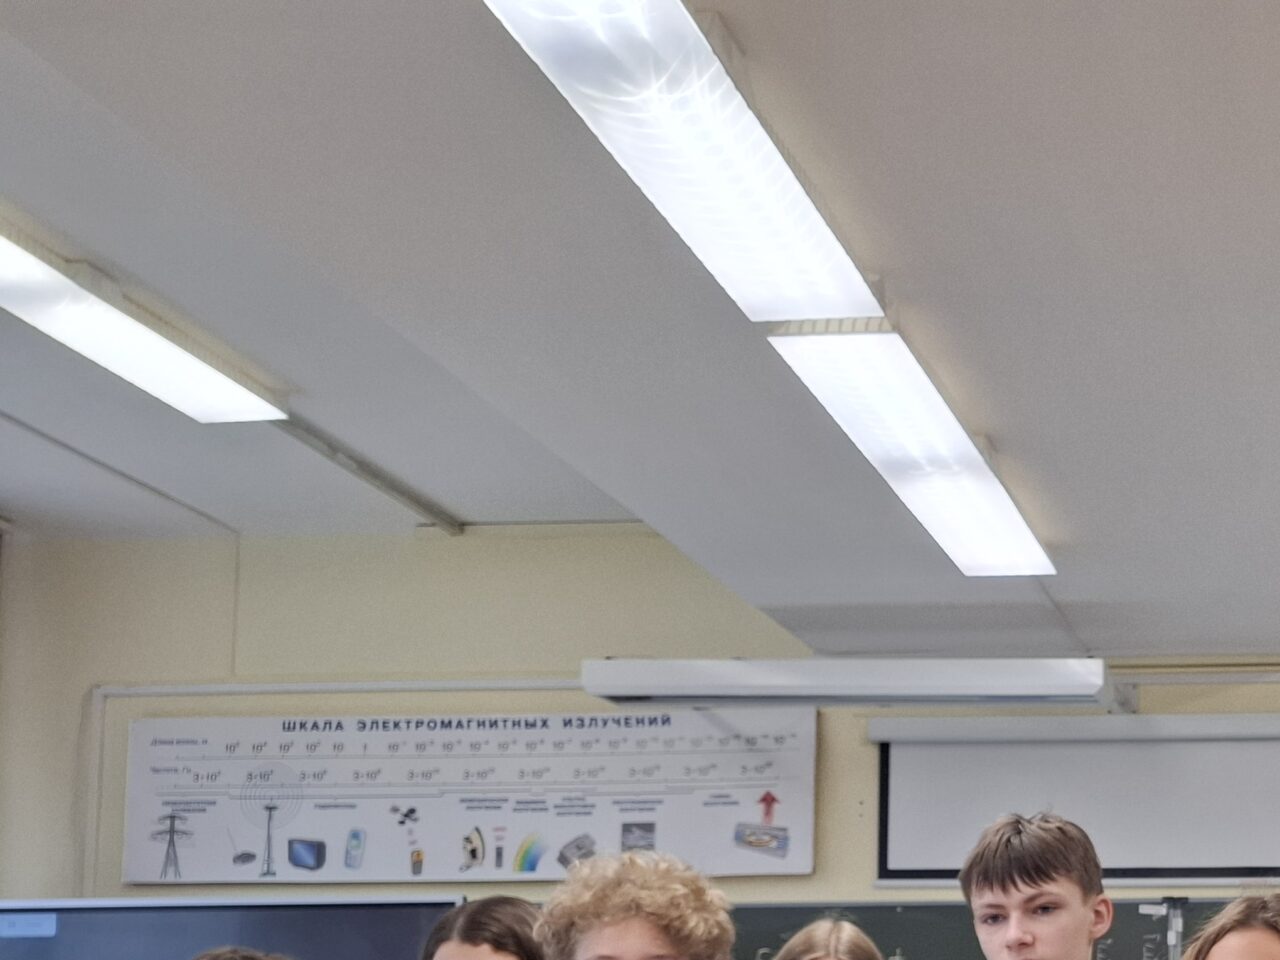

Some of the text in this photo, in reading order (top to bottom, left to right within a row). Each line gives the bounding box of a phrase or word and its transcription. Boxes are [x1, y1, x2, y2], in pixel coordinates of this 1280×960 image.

[282, 713, 672, 733] ШКАЛА ЭЛЕКТРОМАГНИТНЫХ ИЗЛУЧЕНИЙ
